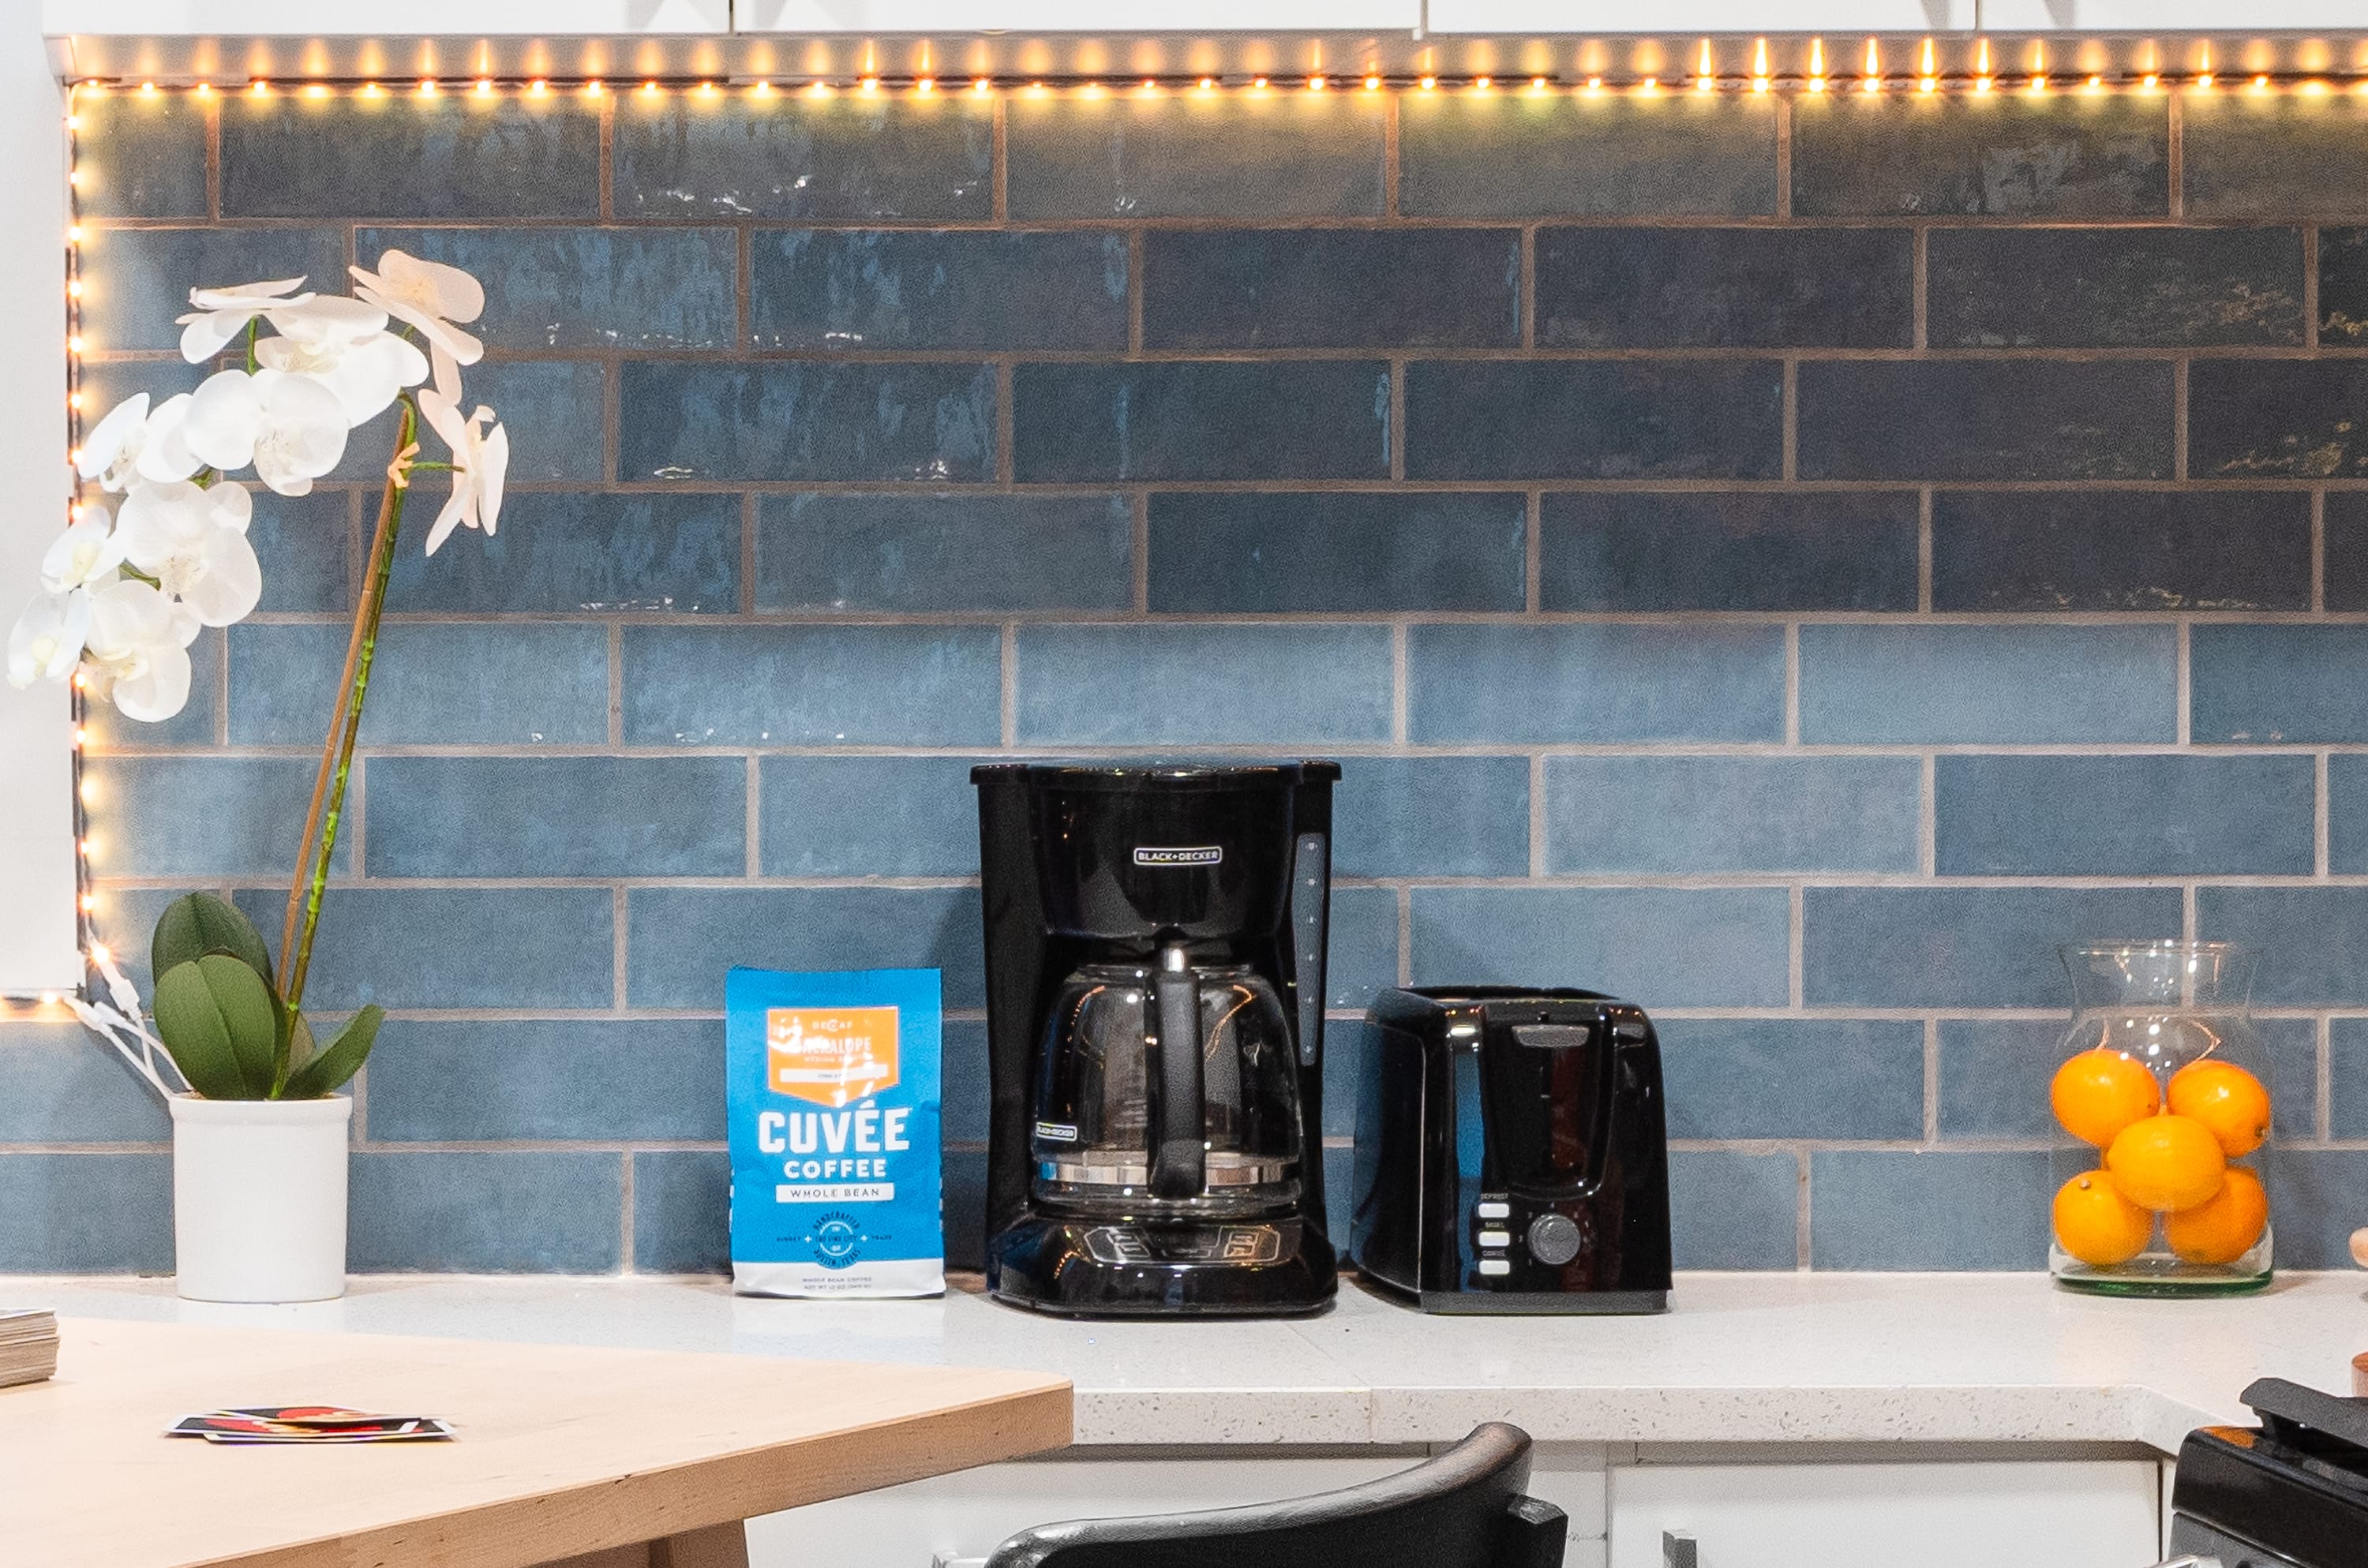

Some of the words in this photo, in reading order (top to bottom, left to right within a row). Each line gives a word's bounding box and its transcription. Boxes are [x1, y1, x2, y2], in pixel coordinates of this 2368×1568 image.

[812, 1019, 852, 1032] DECAF
[759, 1100, 910, 1154] CUVÉE
[783, 1158, 886, 1179] COFFEE
[790, 1188, 838, 1198] WHOLE
[844, 1188, 879, 1197] BEAN
